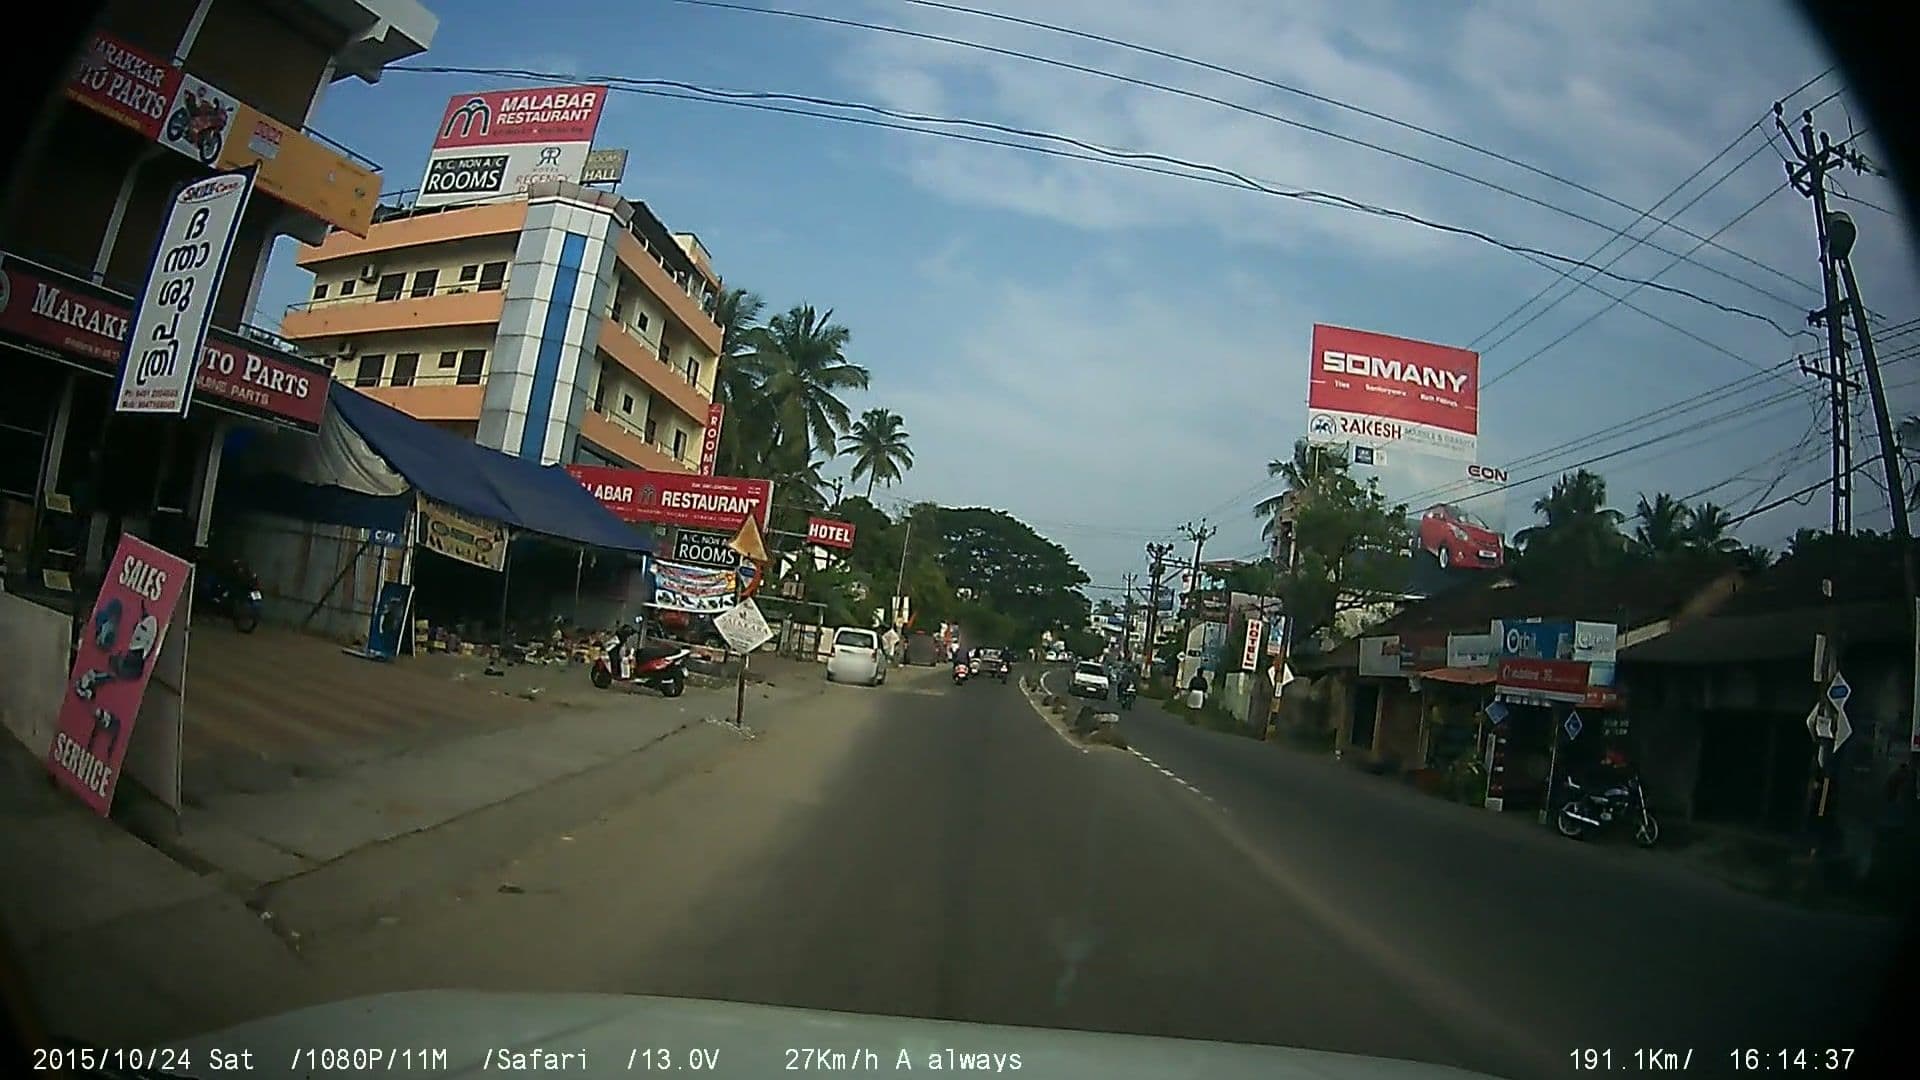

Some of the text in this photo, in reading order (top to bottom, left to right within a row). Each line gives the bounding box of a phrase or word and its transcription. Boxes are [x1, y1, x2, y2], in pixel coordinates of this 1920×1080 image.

[106, 72, 168, 120] PARTS
[500, 93, 596, 113] MALABAR
[496, 109, 592, 125] RESTAURANT
[427, 169, 500, 191] ROOMS
[584, 168, 617, 180] HALL
[242, 353, 309, 398] PARTS
[1321, 350, 1468, 393] SOMANY
[1339, 417, 1402, 440] RAKESH
[703, 415, 719, 476] ROOMS
[1468, 464, 1508, 481] EON
[809, 523, 852, 543] HOTEL
[679, 543, 735, 564] ROOMS
[119, 555, 168, 601] SALES
[54, 732, 112, 798] SERVICE
